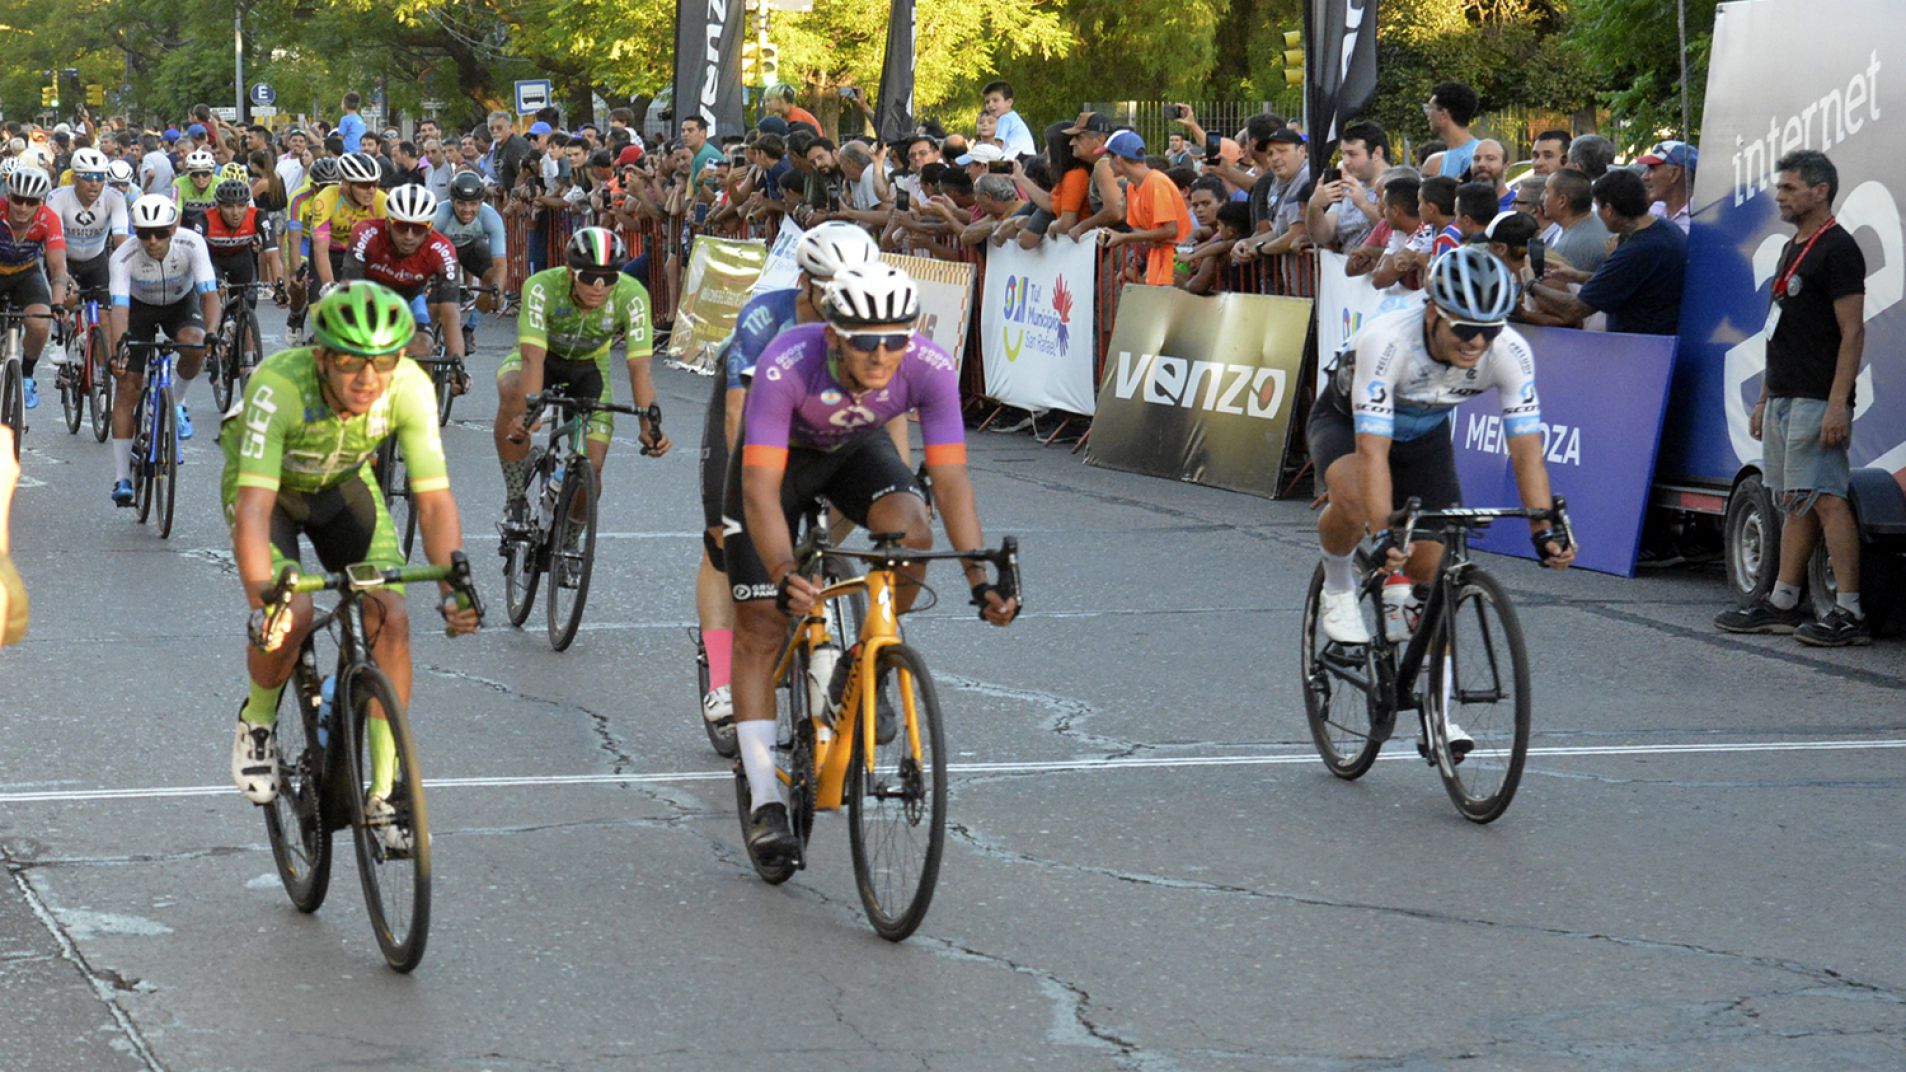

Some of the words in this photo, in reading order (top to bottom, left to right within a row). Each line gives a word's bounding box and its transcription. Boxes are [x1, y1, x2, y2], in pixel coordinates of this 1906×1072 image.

[257, 85, 269, 99] E
[1732, 48, 1882, 208] internet
[431, 241, 456, 281] piorico
[529, 283, 546, 331] SEP
[626, 296, 645, 342] SEP
[1115, 351, 1286, 419] venzo
[241, 385, 277, 459] SEP
